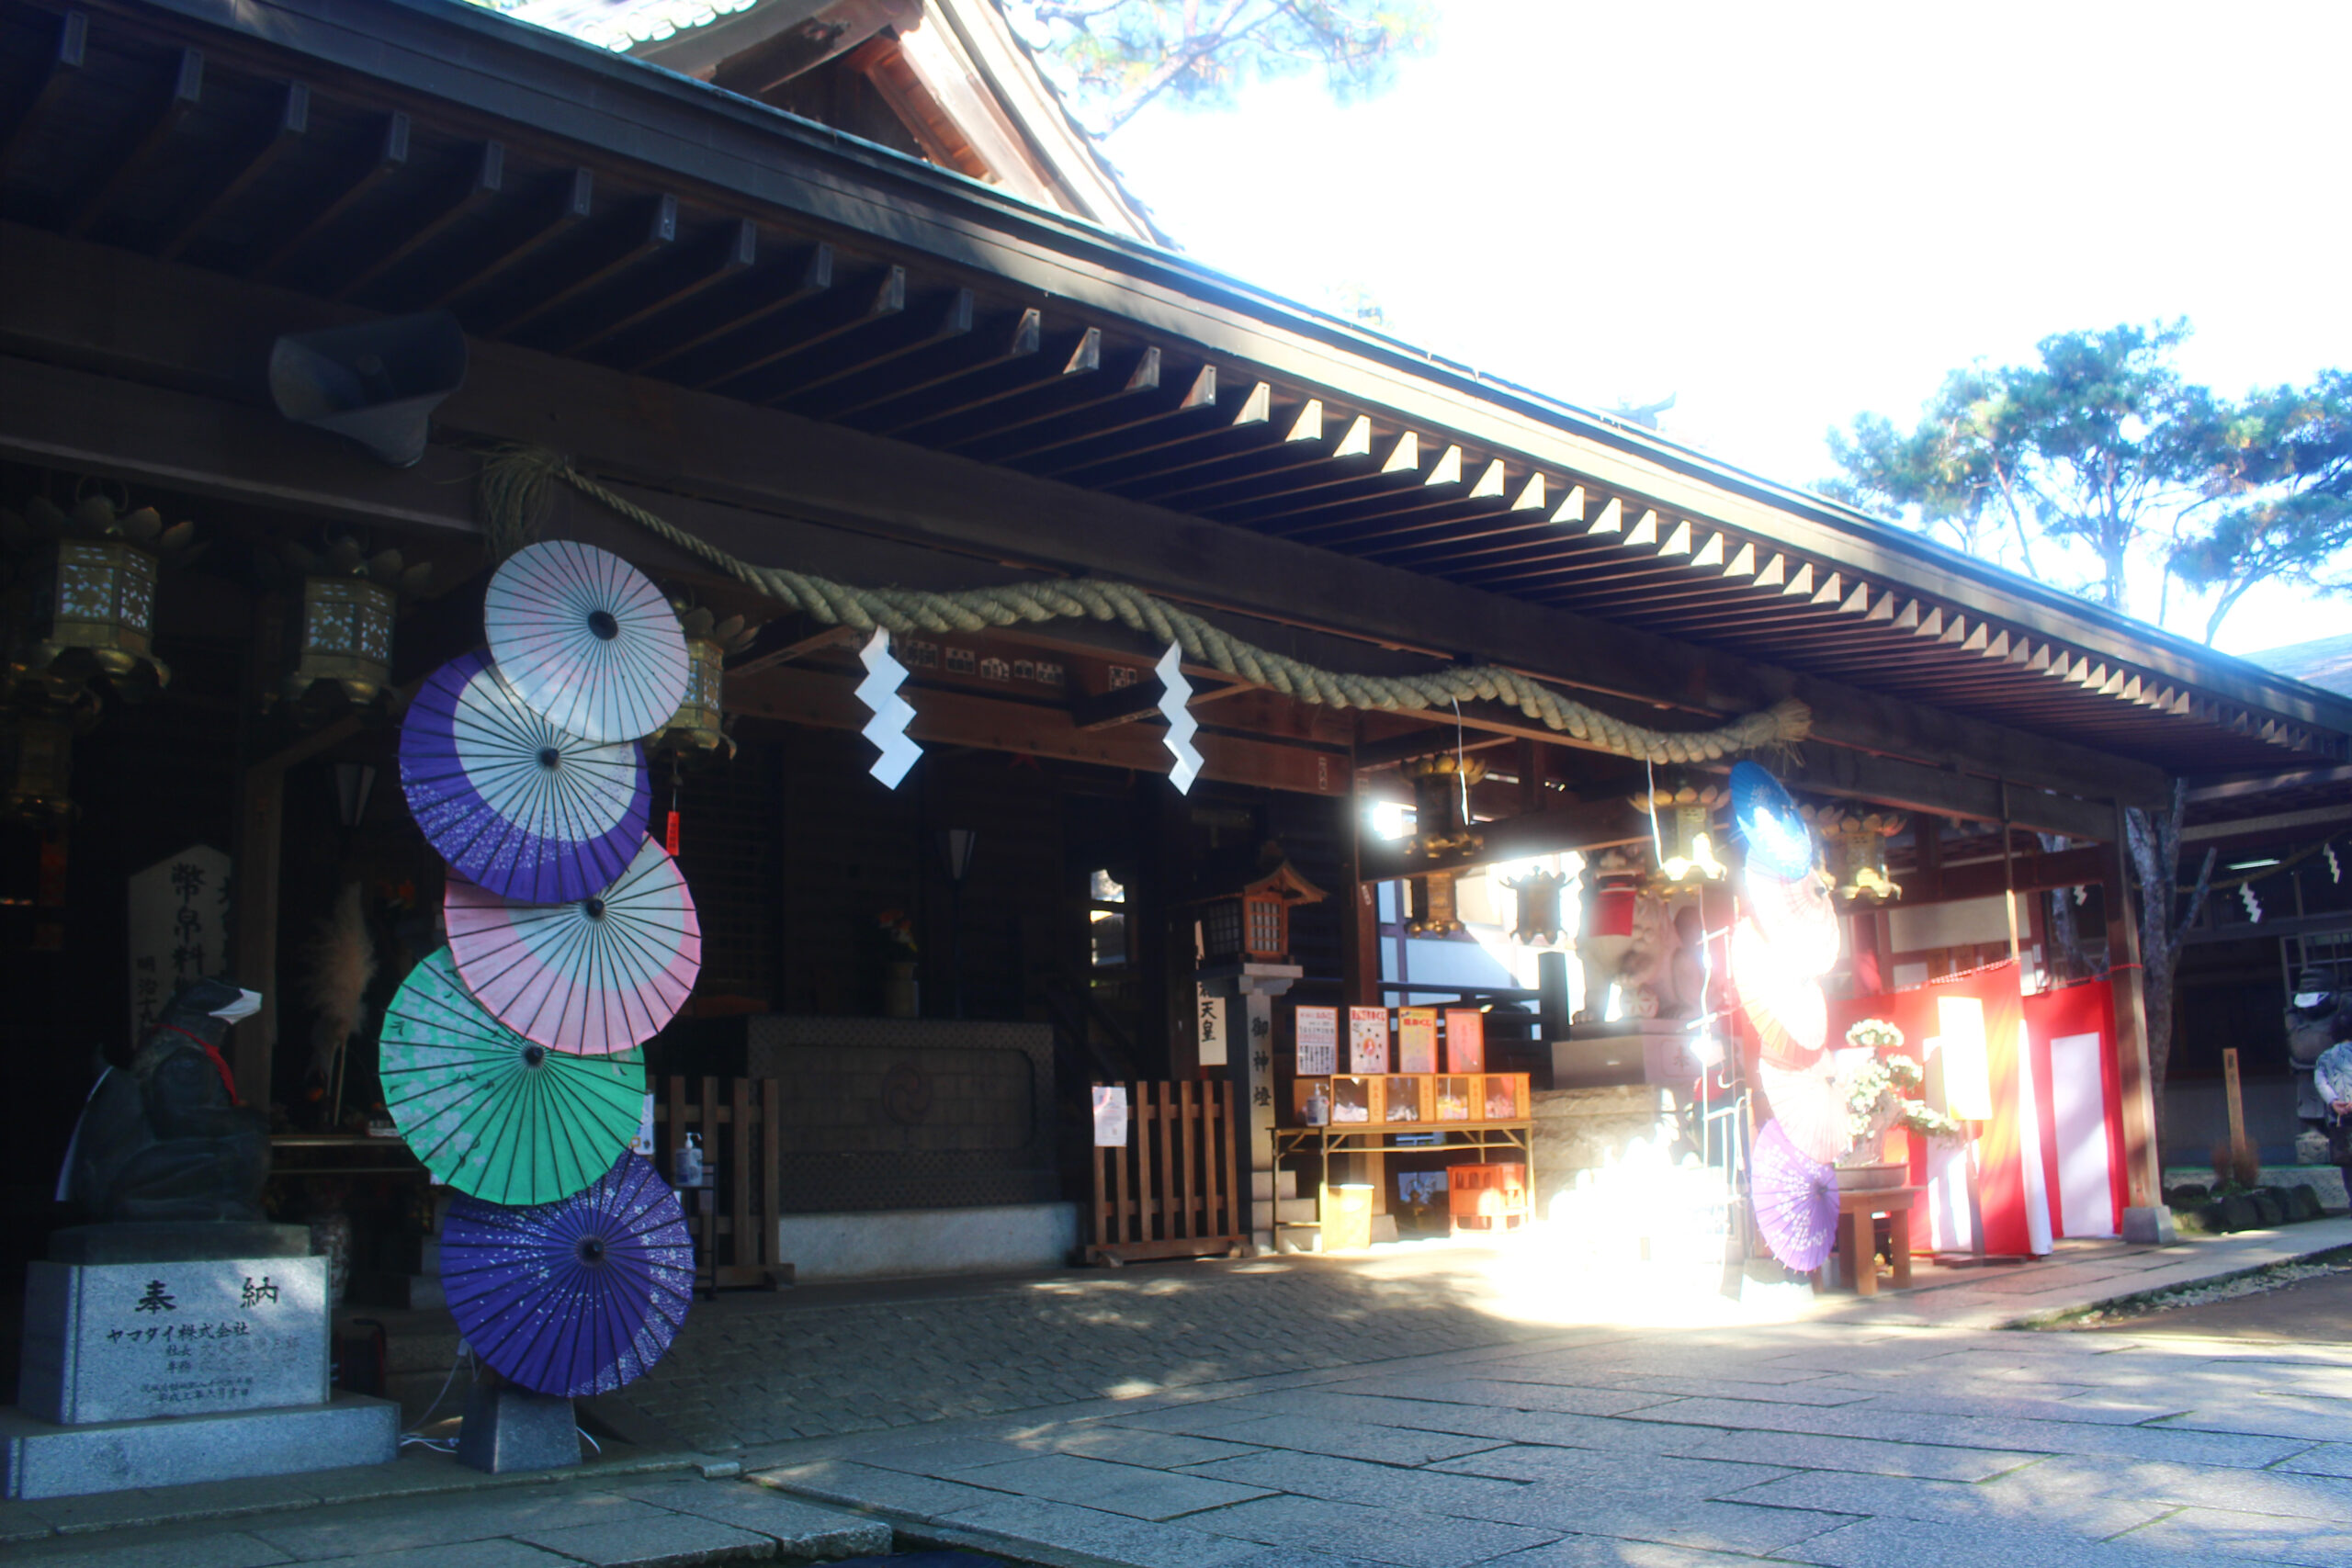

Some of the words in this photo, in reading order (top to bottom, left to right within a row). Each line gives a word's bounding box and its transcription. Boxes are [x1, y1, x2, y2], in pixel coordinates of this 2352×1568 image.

[1250, 1016, 1272, 1107] 御神燈
[134, 1277, 279, 1314] 奉納
[107, 1321, 251, 1345] ヤマダイ株式会社
